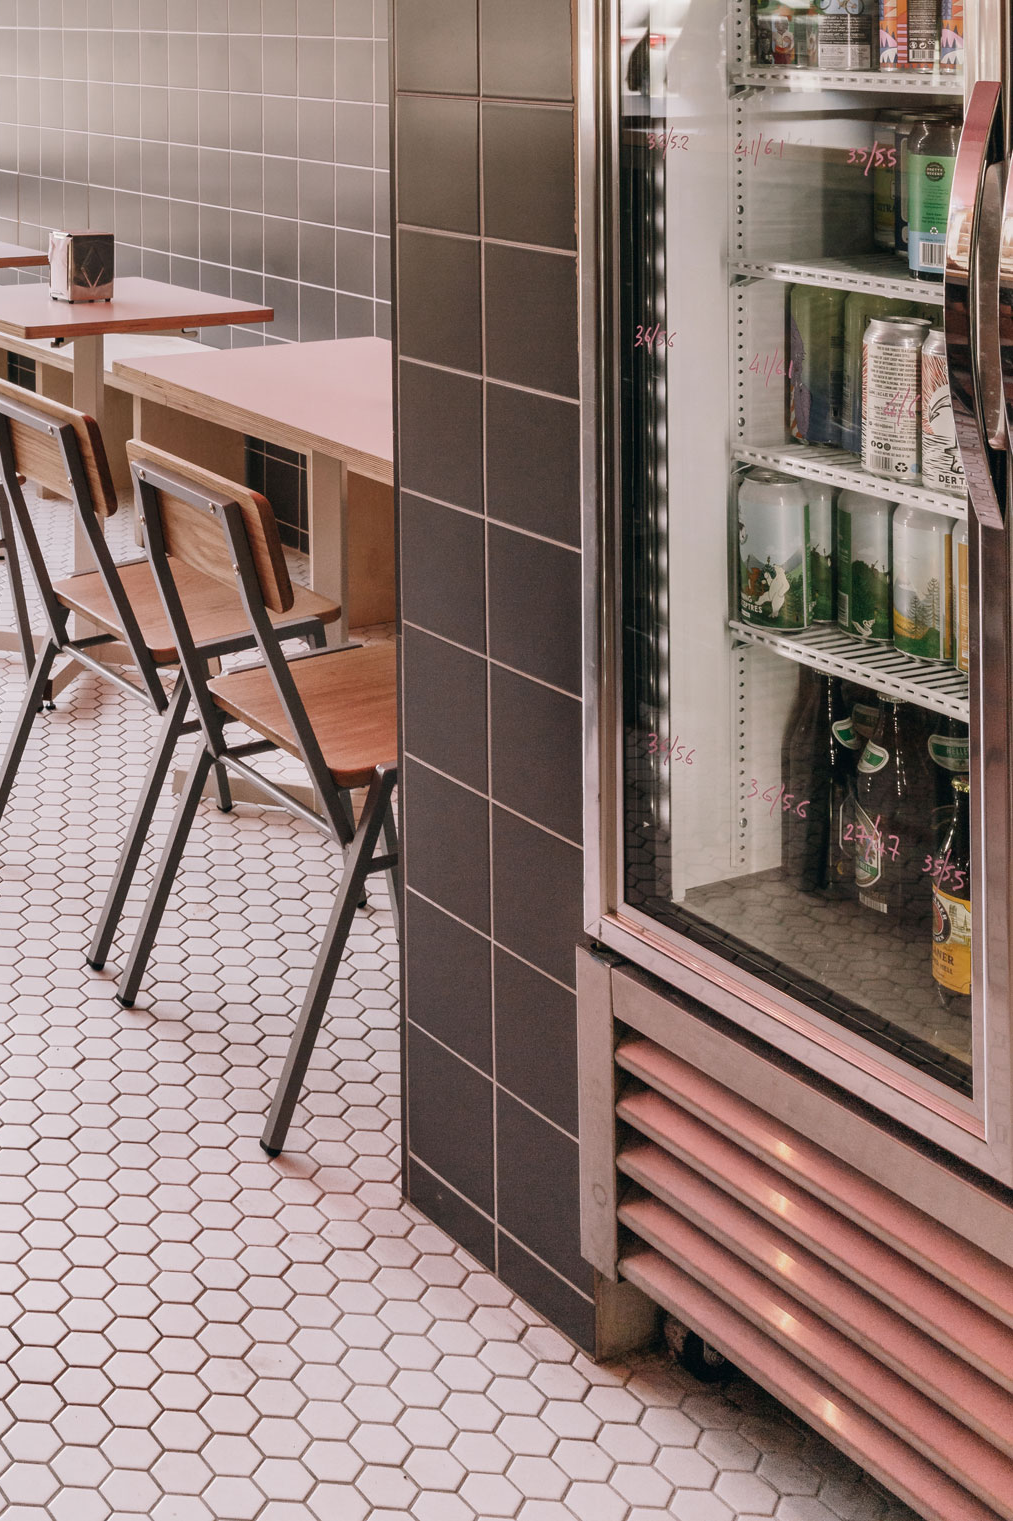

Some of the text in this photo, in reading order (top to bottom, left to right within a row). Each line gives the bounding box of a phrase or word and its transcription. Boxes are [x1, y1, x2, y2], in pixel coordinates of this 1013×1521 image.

[938, 474, 957, 485] DER
[946, 745, 969, 760] HELLE
[747, 779, 810, 818] 3.6/5.6
